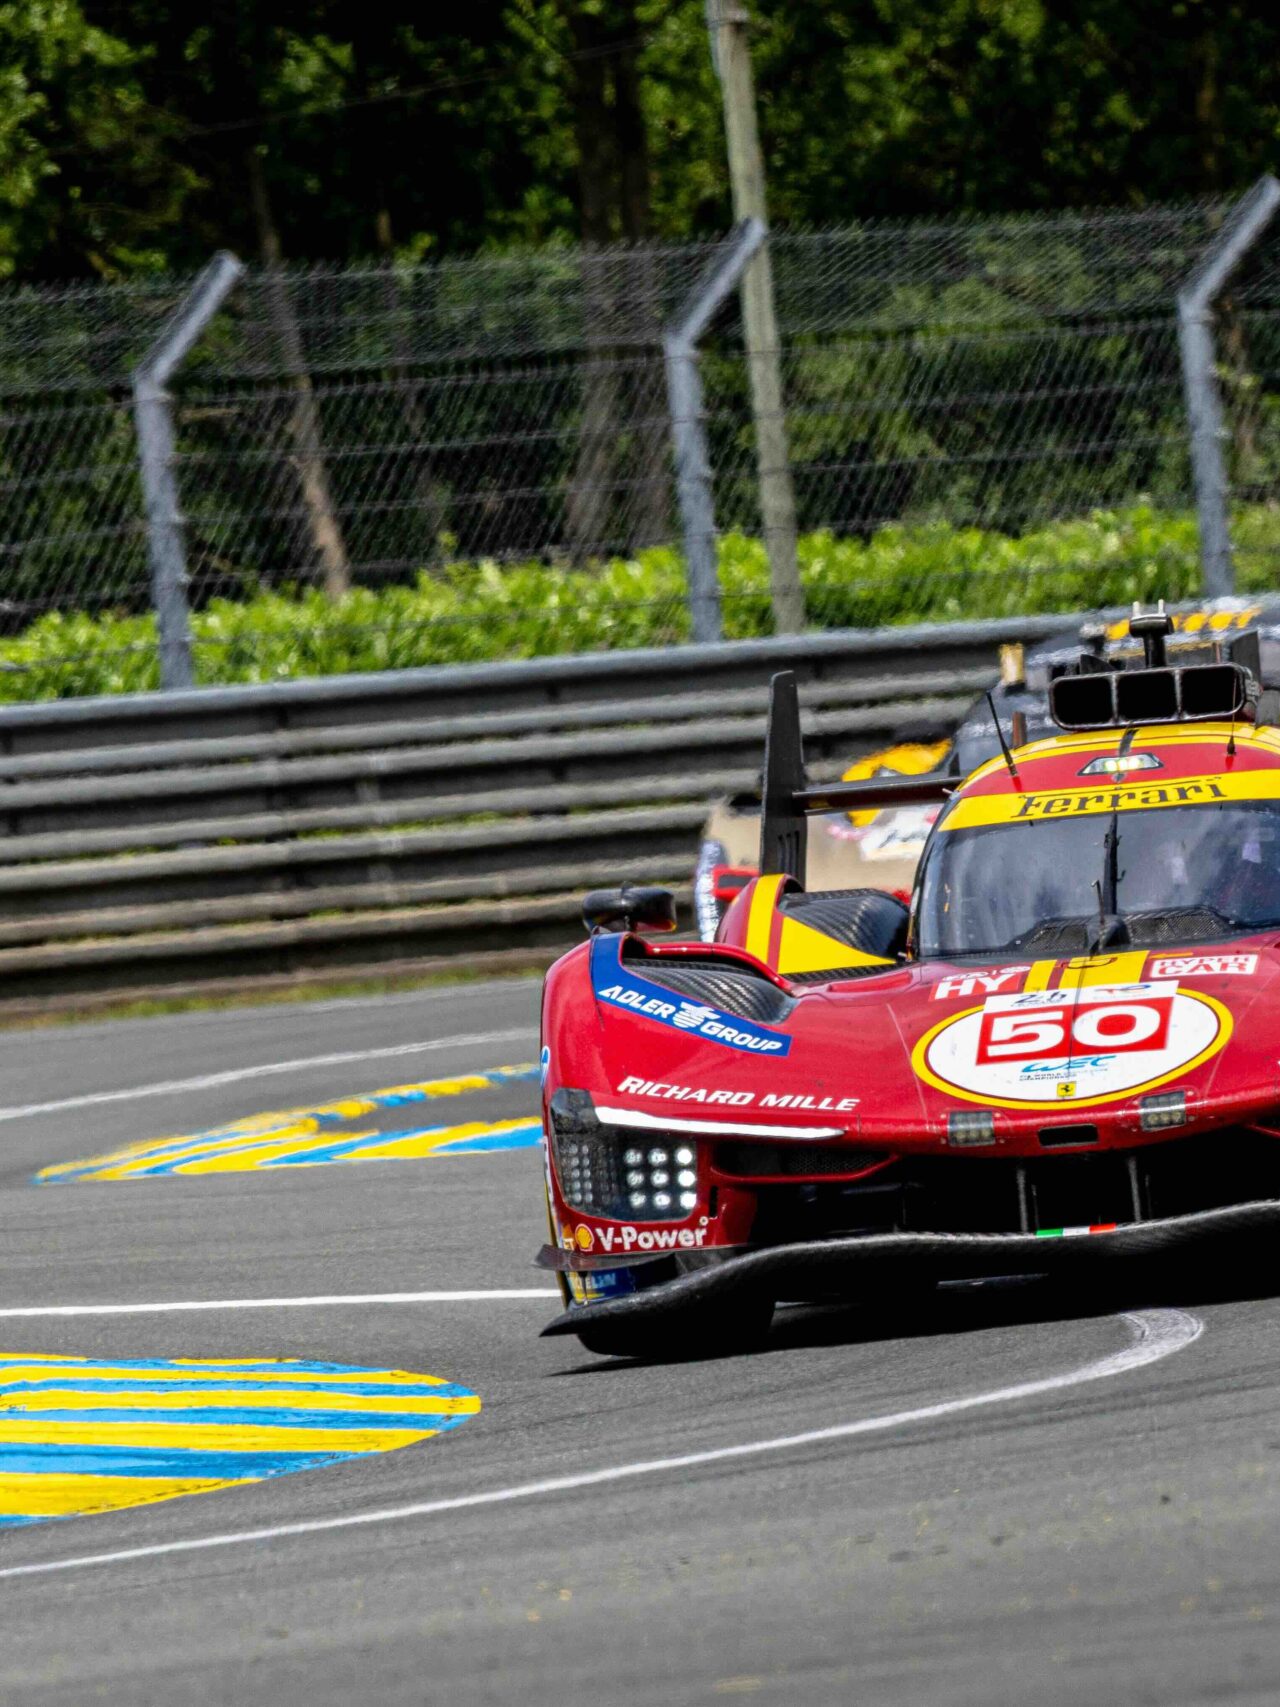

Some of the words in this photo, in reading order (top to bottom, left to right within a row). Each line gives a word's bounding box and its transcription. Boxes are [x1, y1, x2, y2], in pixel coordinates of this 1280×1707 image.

[1010, 776, 1227, 818] Ferrari
[1158, 962, 1246, 975] CAR
[934, 973, 1016, 999] HY
[598, 985, 676, 1019] ADLER
[700, 1021, 783, 1051] GROUP
[987, 1005, 1161, 1056] 50
[1021, 1055, 1117, 1072] WEC
[617, 1075, 756, 1105] RICHARD
[759, 1092, 860, 1111] MILLE
[595, 1225, 708, 1251] V-Power
